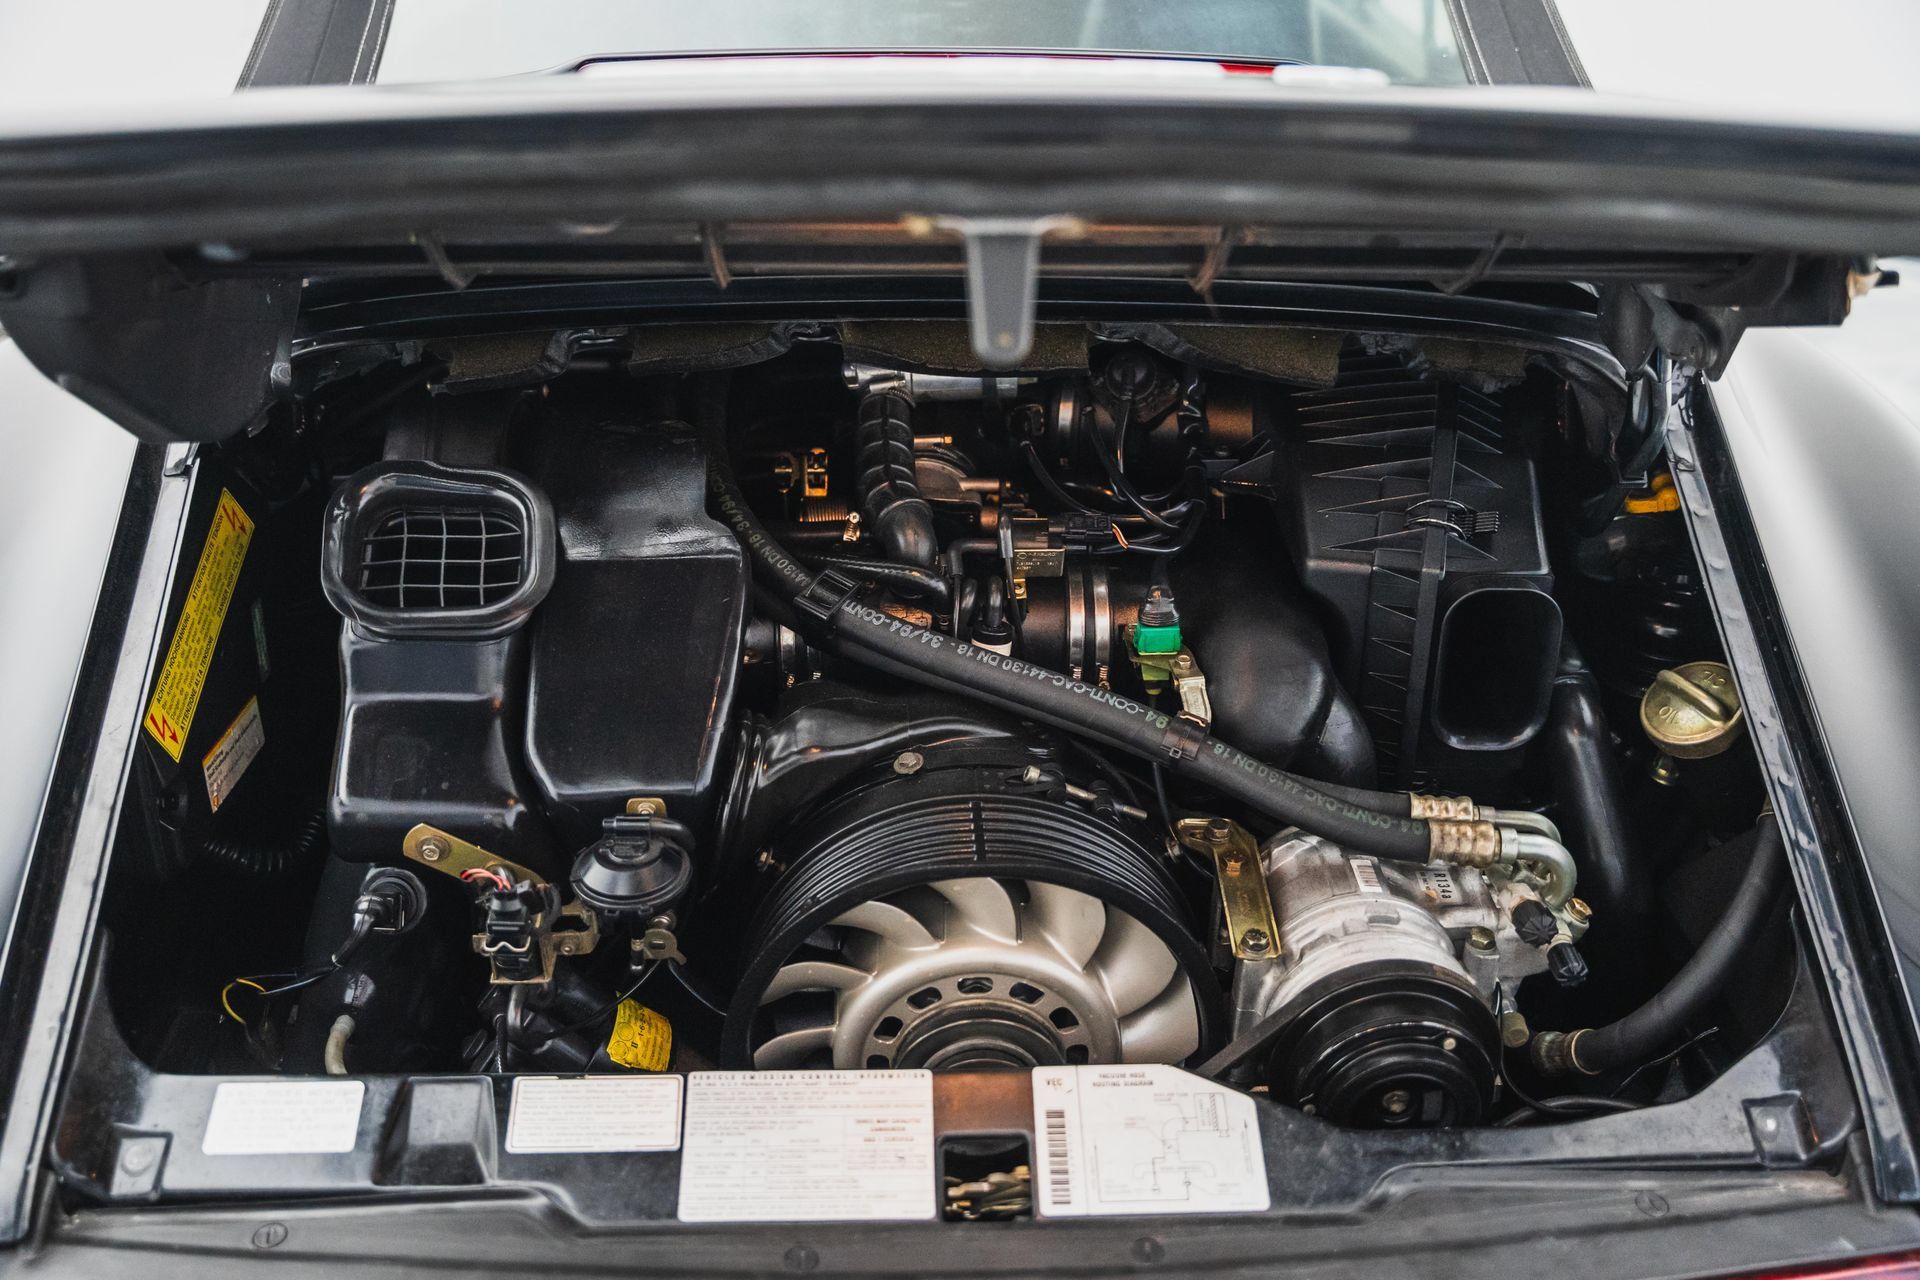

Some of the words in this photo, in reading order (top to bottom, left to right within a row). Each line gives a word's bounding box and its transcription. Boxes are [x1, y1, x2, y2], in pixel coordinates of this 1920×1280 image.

[192, 563, 207, 601] ATTENTION
[205, 541, 214, 564] HAUTE
[213, 514, 224, 542] TENSION
[761, 546, 782, 565] DN
[218, 589, 229, 618] DANGER
[233, 542, 244, 573] VOLTAGE
[157, 668, 171, 705] ACHTUNG
[169, 611, 191, 670] HOCHSPANNUNG
[976, 650, 1001, 667] DN
[180, 687, 197, 732] ATTENZIONE
[195, 668, 203, 688] ALTA
[201, 635, 214, 669] TENSIONE
[1233, 753, 1257, 773] DN
[1433, 872, 1452, 900] R134a
[1123, 1079, 1153, 1087] DIAGRAM
